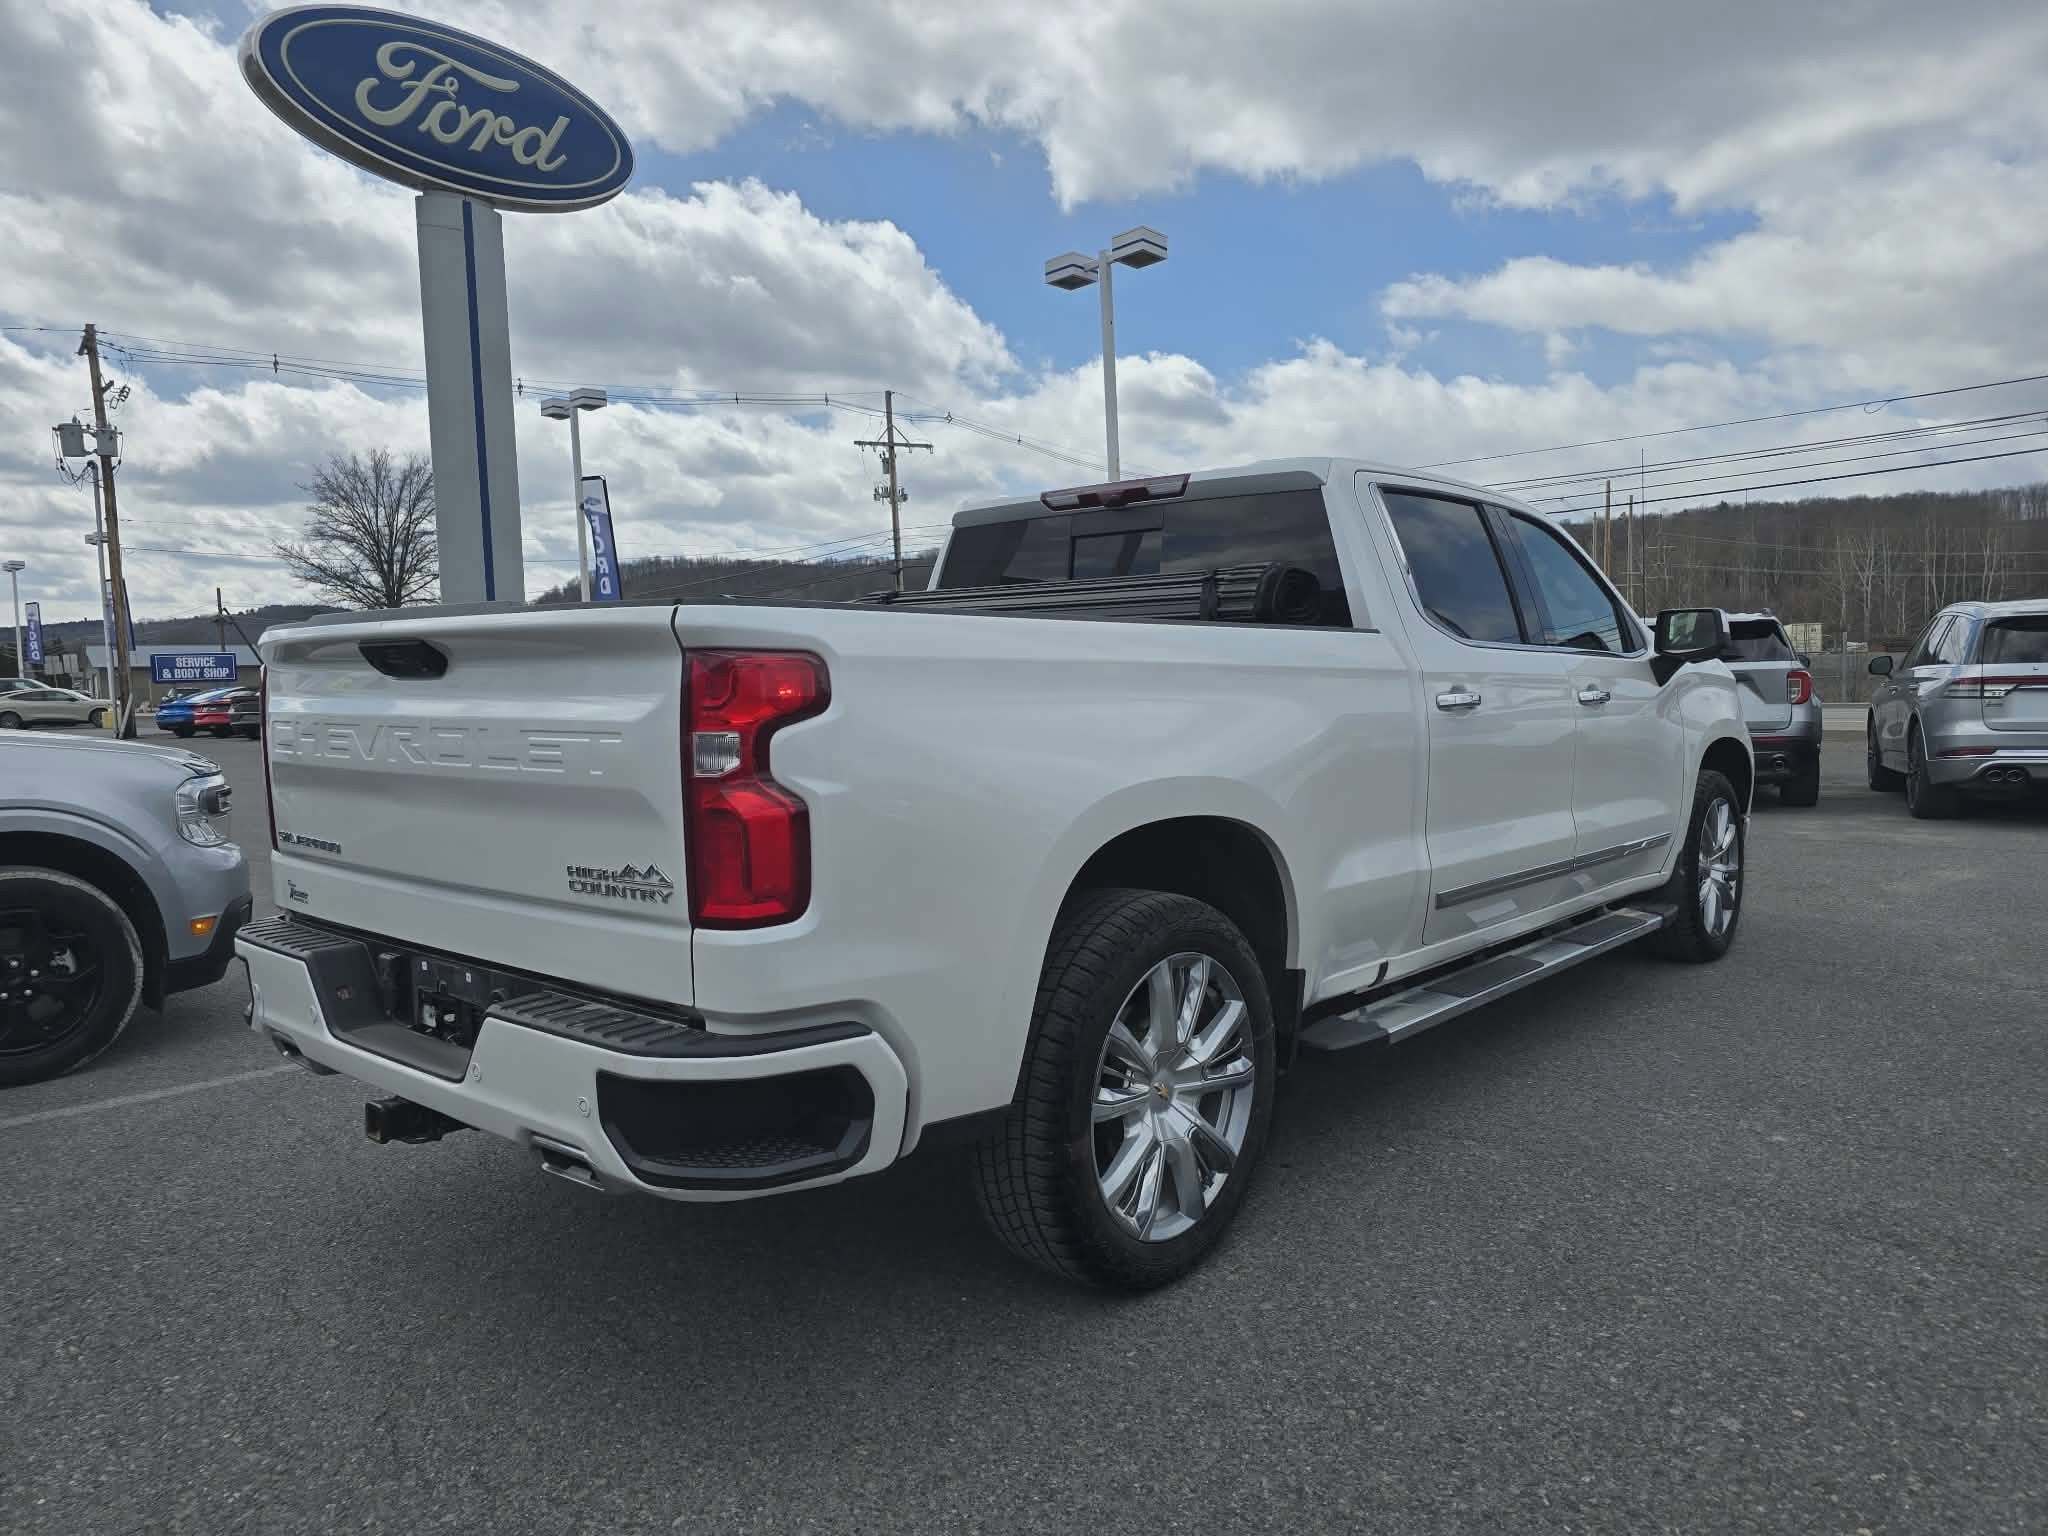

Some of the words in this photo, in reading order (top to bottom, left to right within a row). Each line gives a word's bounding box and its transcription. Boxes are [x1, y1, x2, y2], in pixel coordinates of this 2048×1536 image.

[355, 41, 571, 172] Ford
[175, 656, 216, 667] SERVICE
[162, 668, 172, 679] &
[174, 667, 200, 679] BODY
[203, 667, 230, 679] SHOP
[271, 720, 623, 776] CHEVROLET
[566, 865, 621, 881] HIGH
[568, 880, 673, 904] COUNTRY
